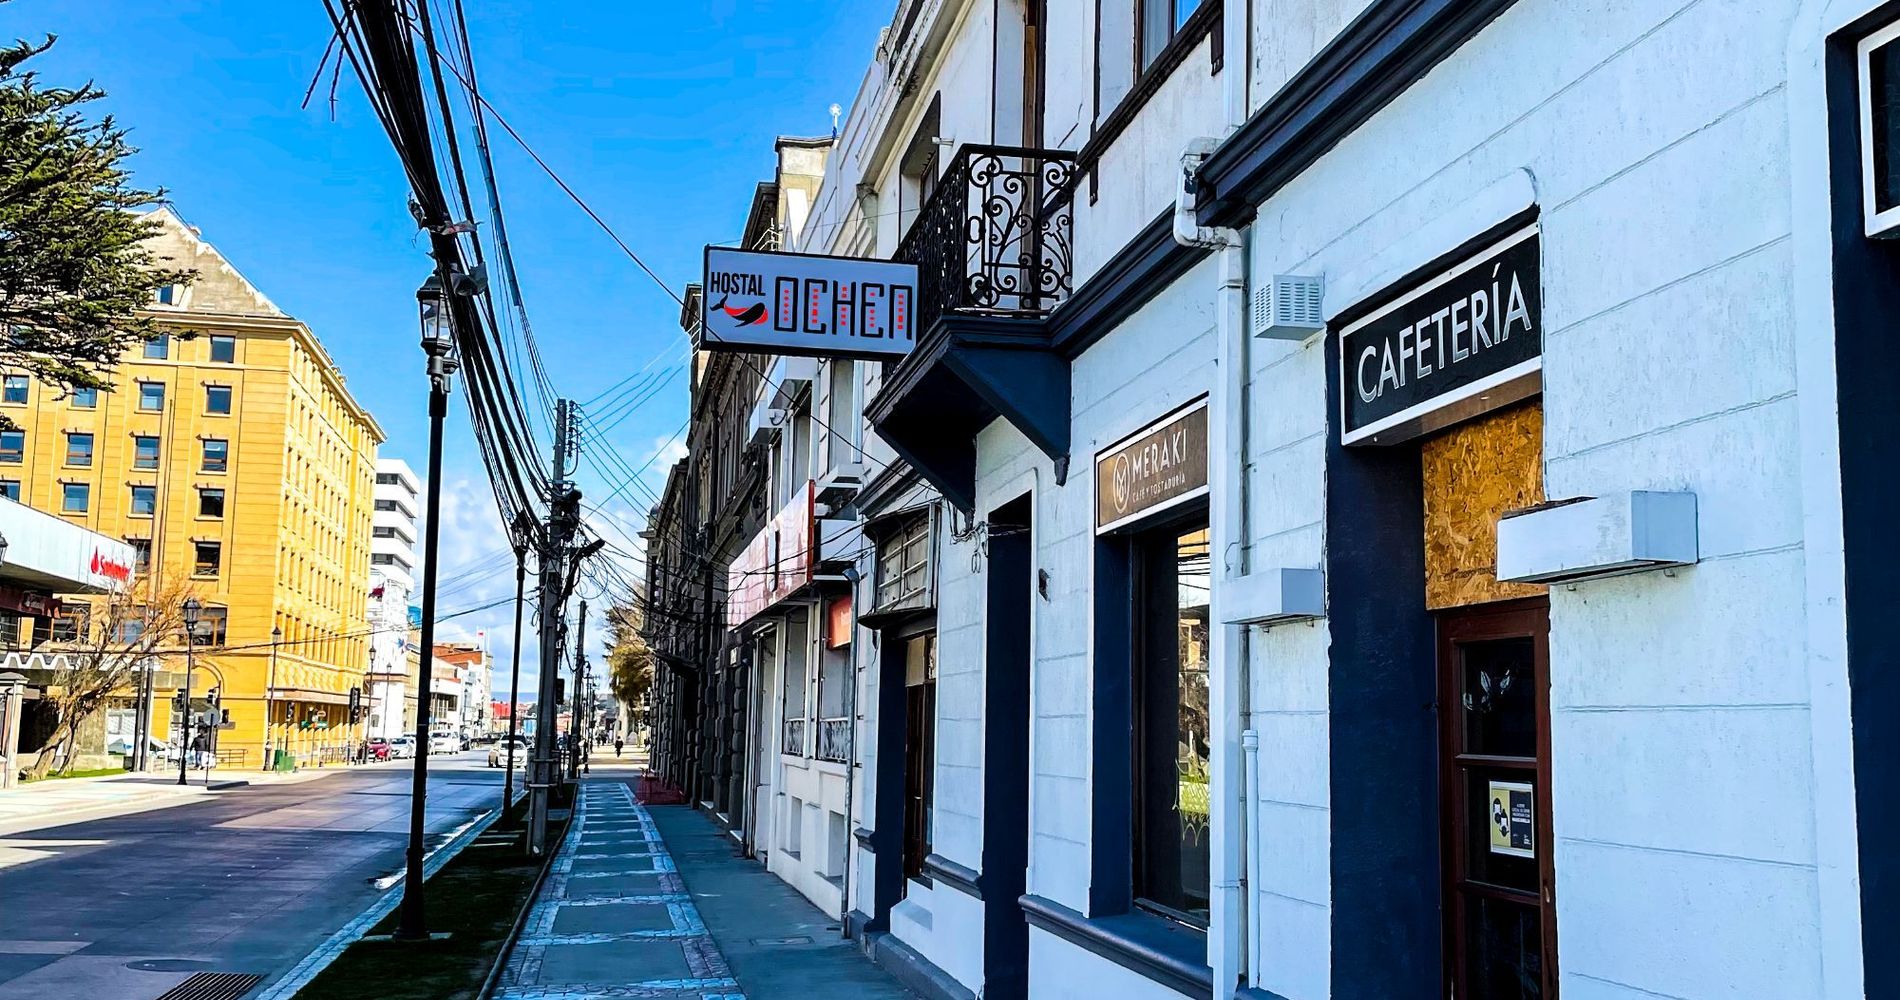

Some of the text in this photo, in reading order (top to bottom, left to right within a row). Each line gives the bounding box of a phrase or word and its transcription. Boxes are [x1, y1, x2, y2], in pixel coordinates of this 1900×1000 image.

[710, 271, 766, 297] HOSTAL
[1357, 262, 1532, 403] CAFETERÍA
[1132, 428, 1187, 483] MERAKI
